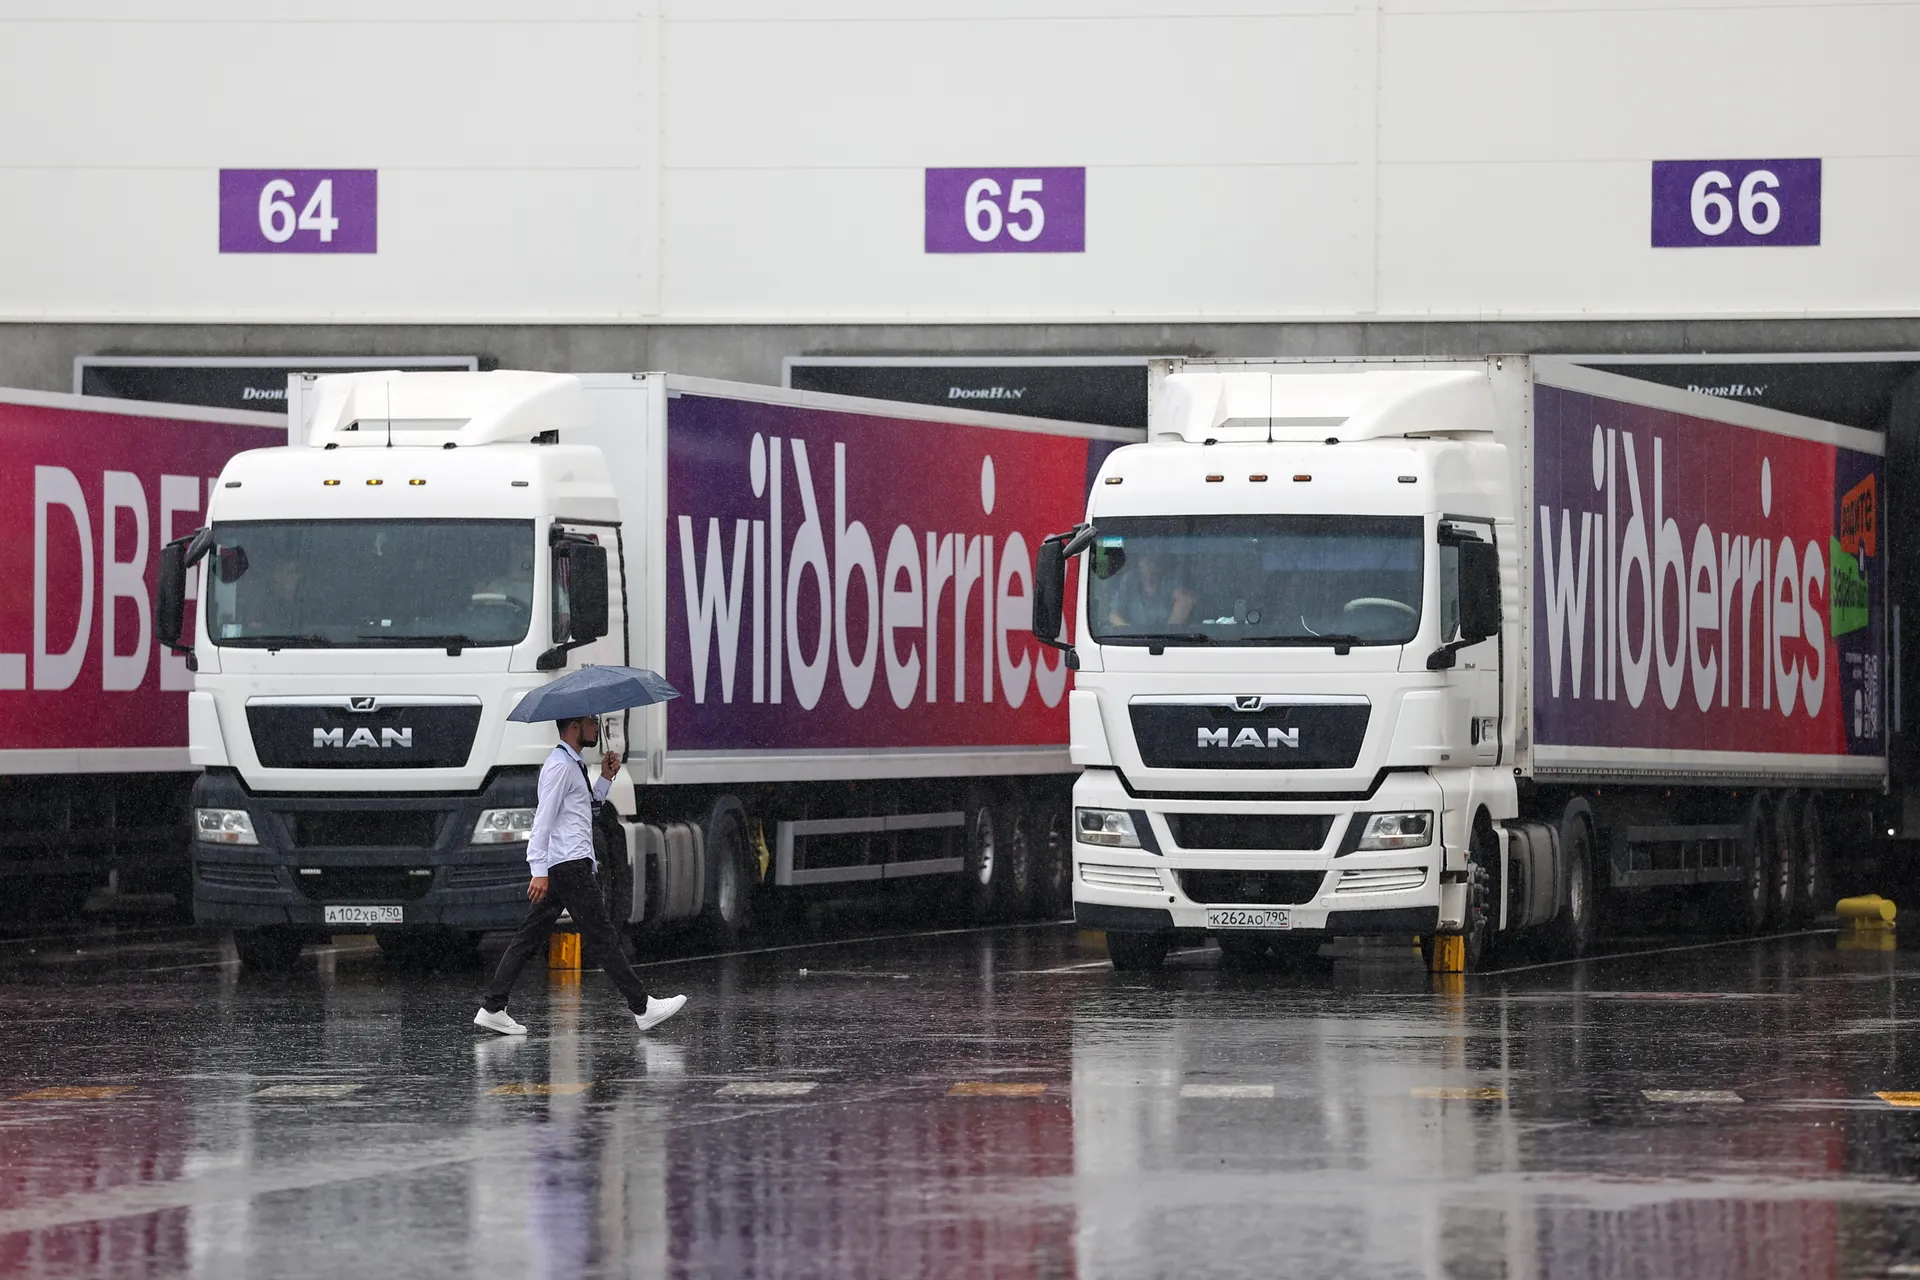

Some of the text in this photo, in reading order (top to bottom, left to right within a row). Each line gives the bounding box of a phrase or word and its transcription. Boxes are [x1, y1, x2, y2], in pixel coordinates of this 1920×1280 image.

[259, 179, 339, 243] 64
[965, 178, 1044, 242] 65
[1691, 170, 1780, 235] 66
[0, 465, 218, 691] DBE
[1540, 424, 1825, 717] wildberries
[313, 727, 412, 747] MAN
[1197, 727, 1299, 747] MAN
[380, 907, 400, 917] 750
[1265, 911, 1285, 921] 790
